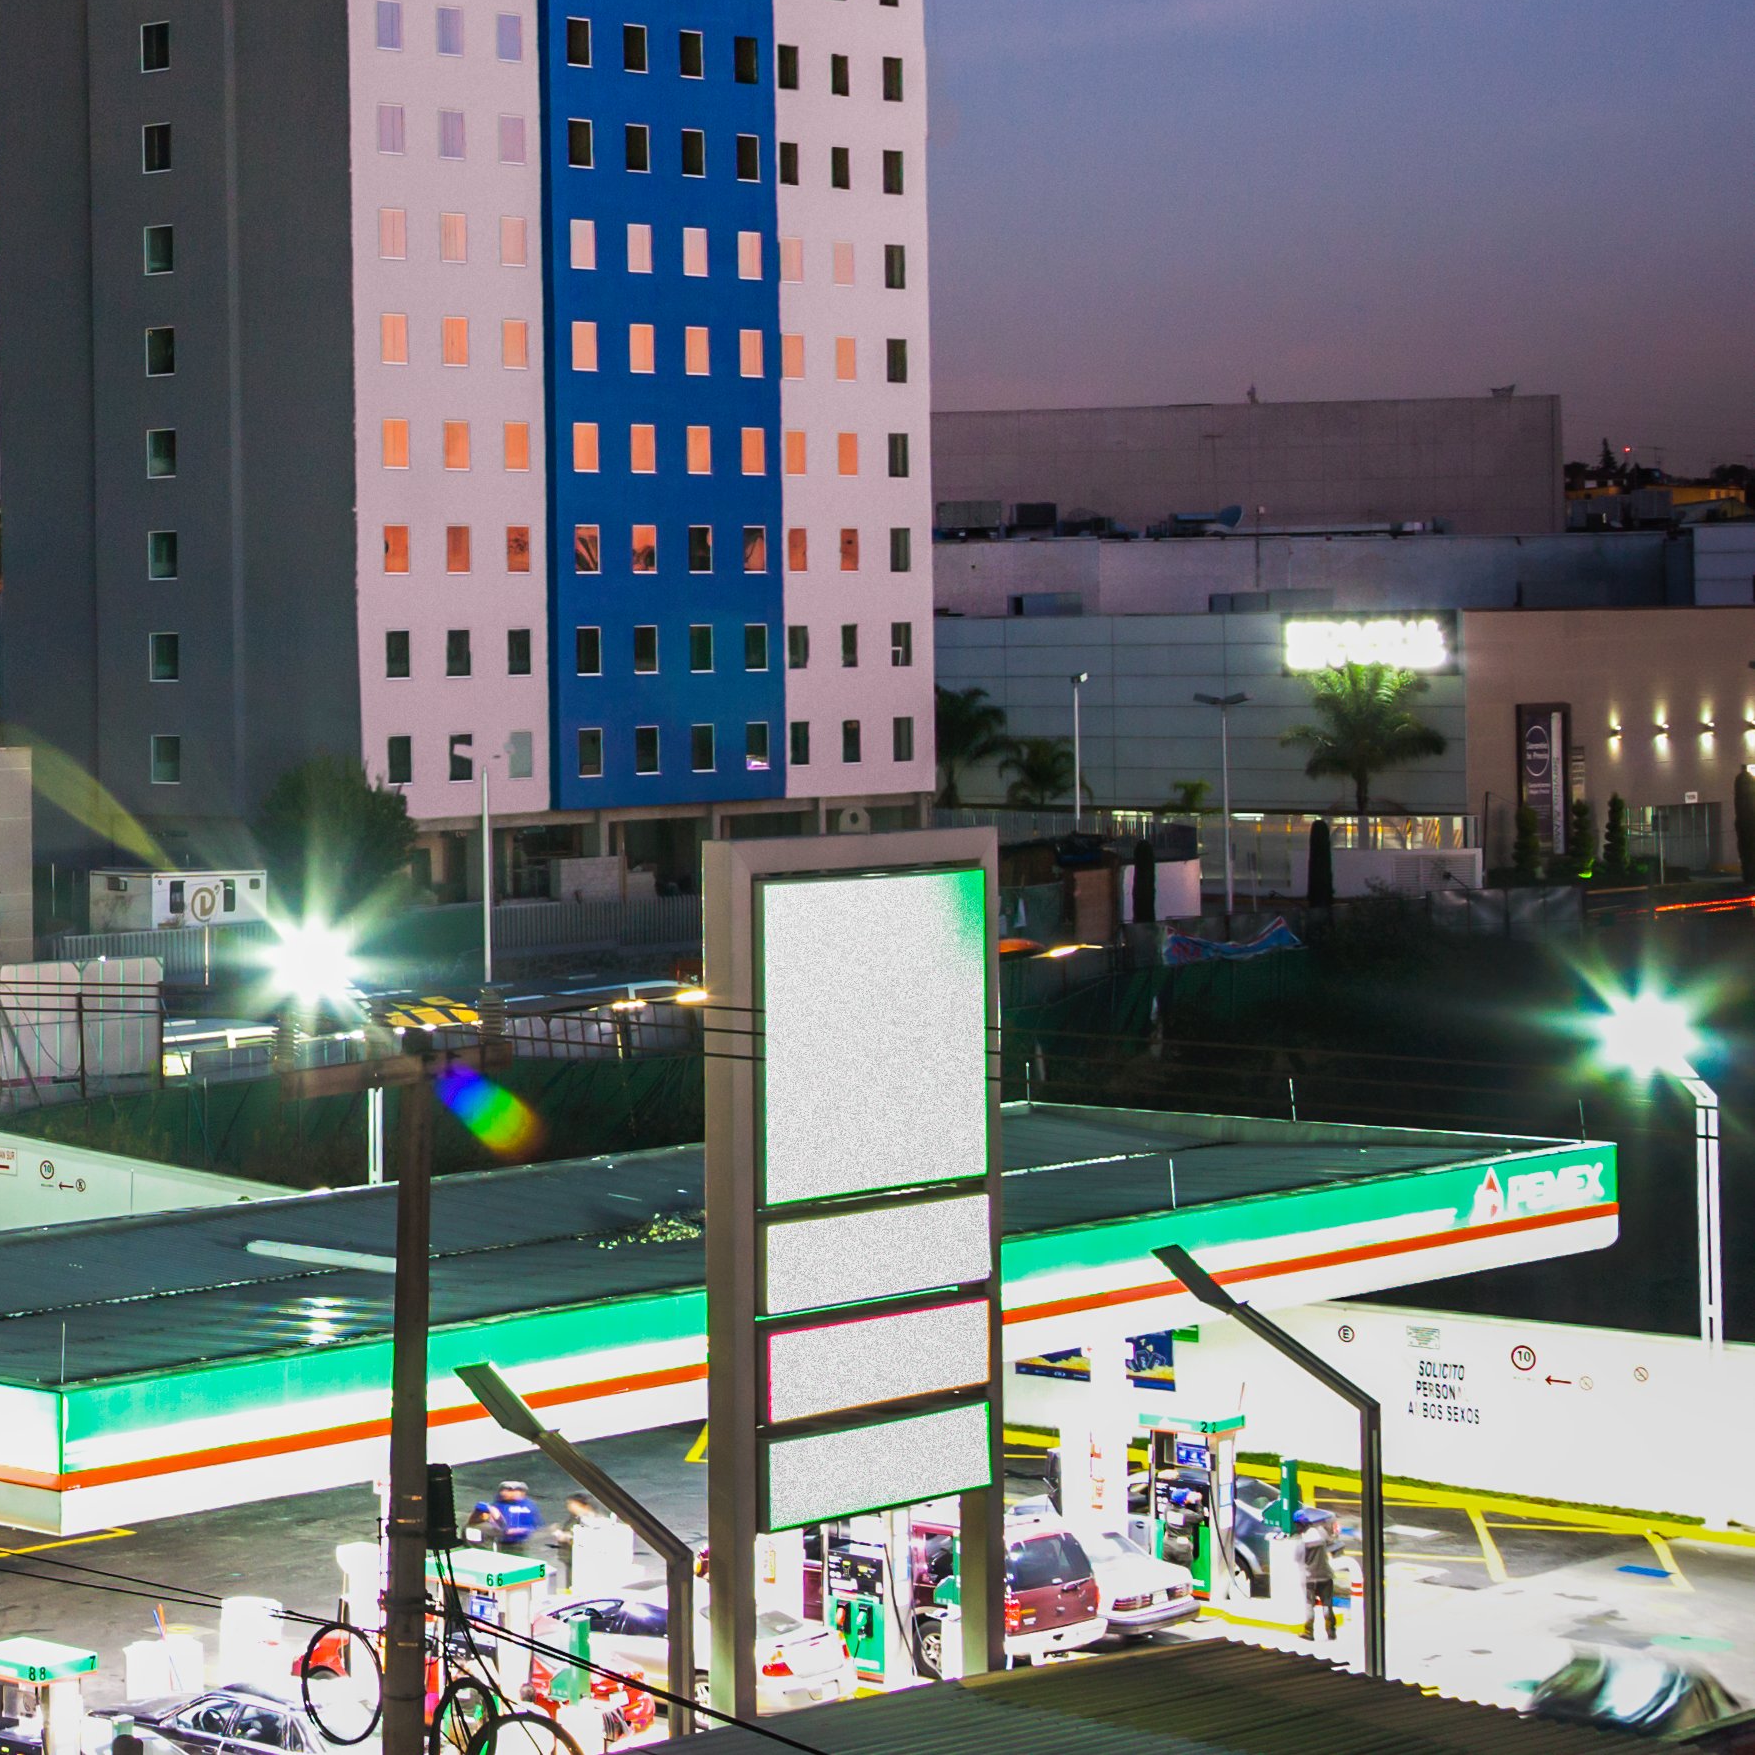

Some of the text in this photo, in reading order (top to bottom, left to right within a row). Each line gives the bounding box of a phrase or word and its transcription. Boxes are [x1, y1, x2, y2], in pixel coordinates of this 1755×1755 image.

[43, 1164, 52, 1174] 10
[1507, 1162, 1606, 1210] PEMEX
[1516, 1350, 1531, 1362] 10
[1418, 1361, 1465, 1380] SOLICITO
[1416, 1380, 1469, 1402] PERSON
[1407, 1401, 1480, 1425] ABOS SEXOS
